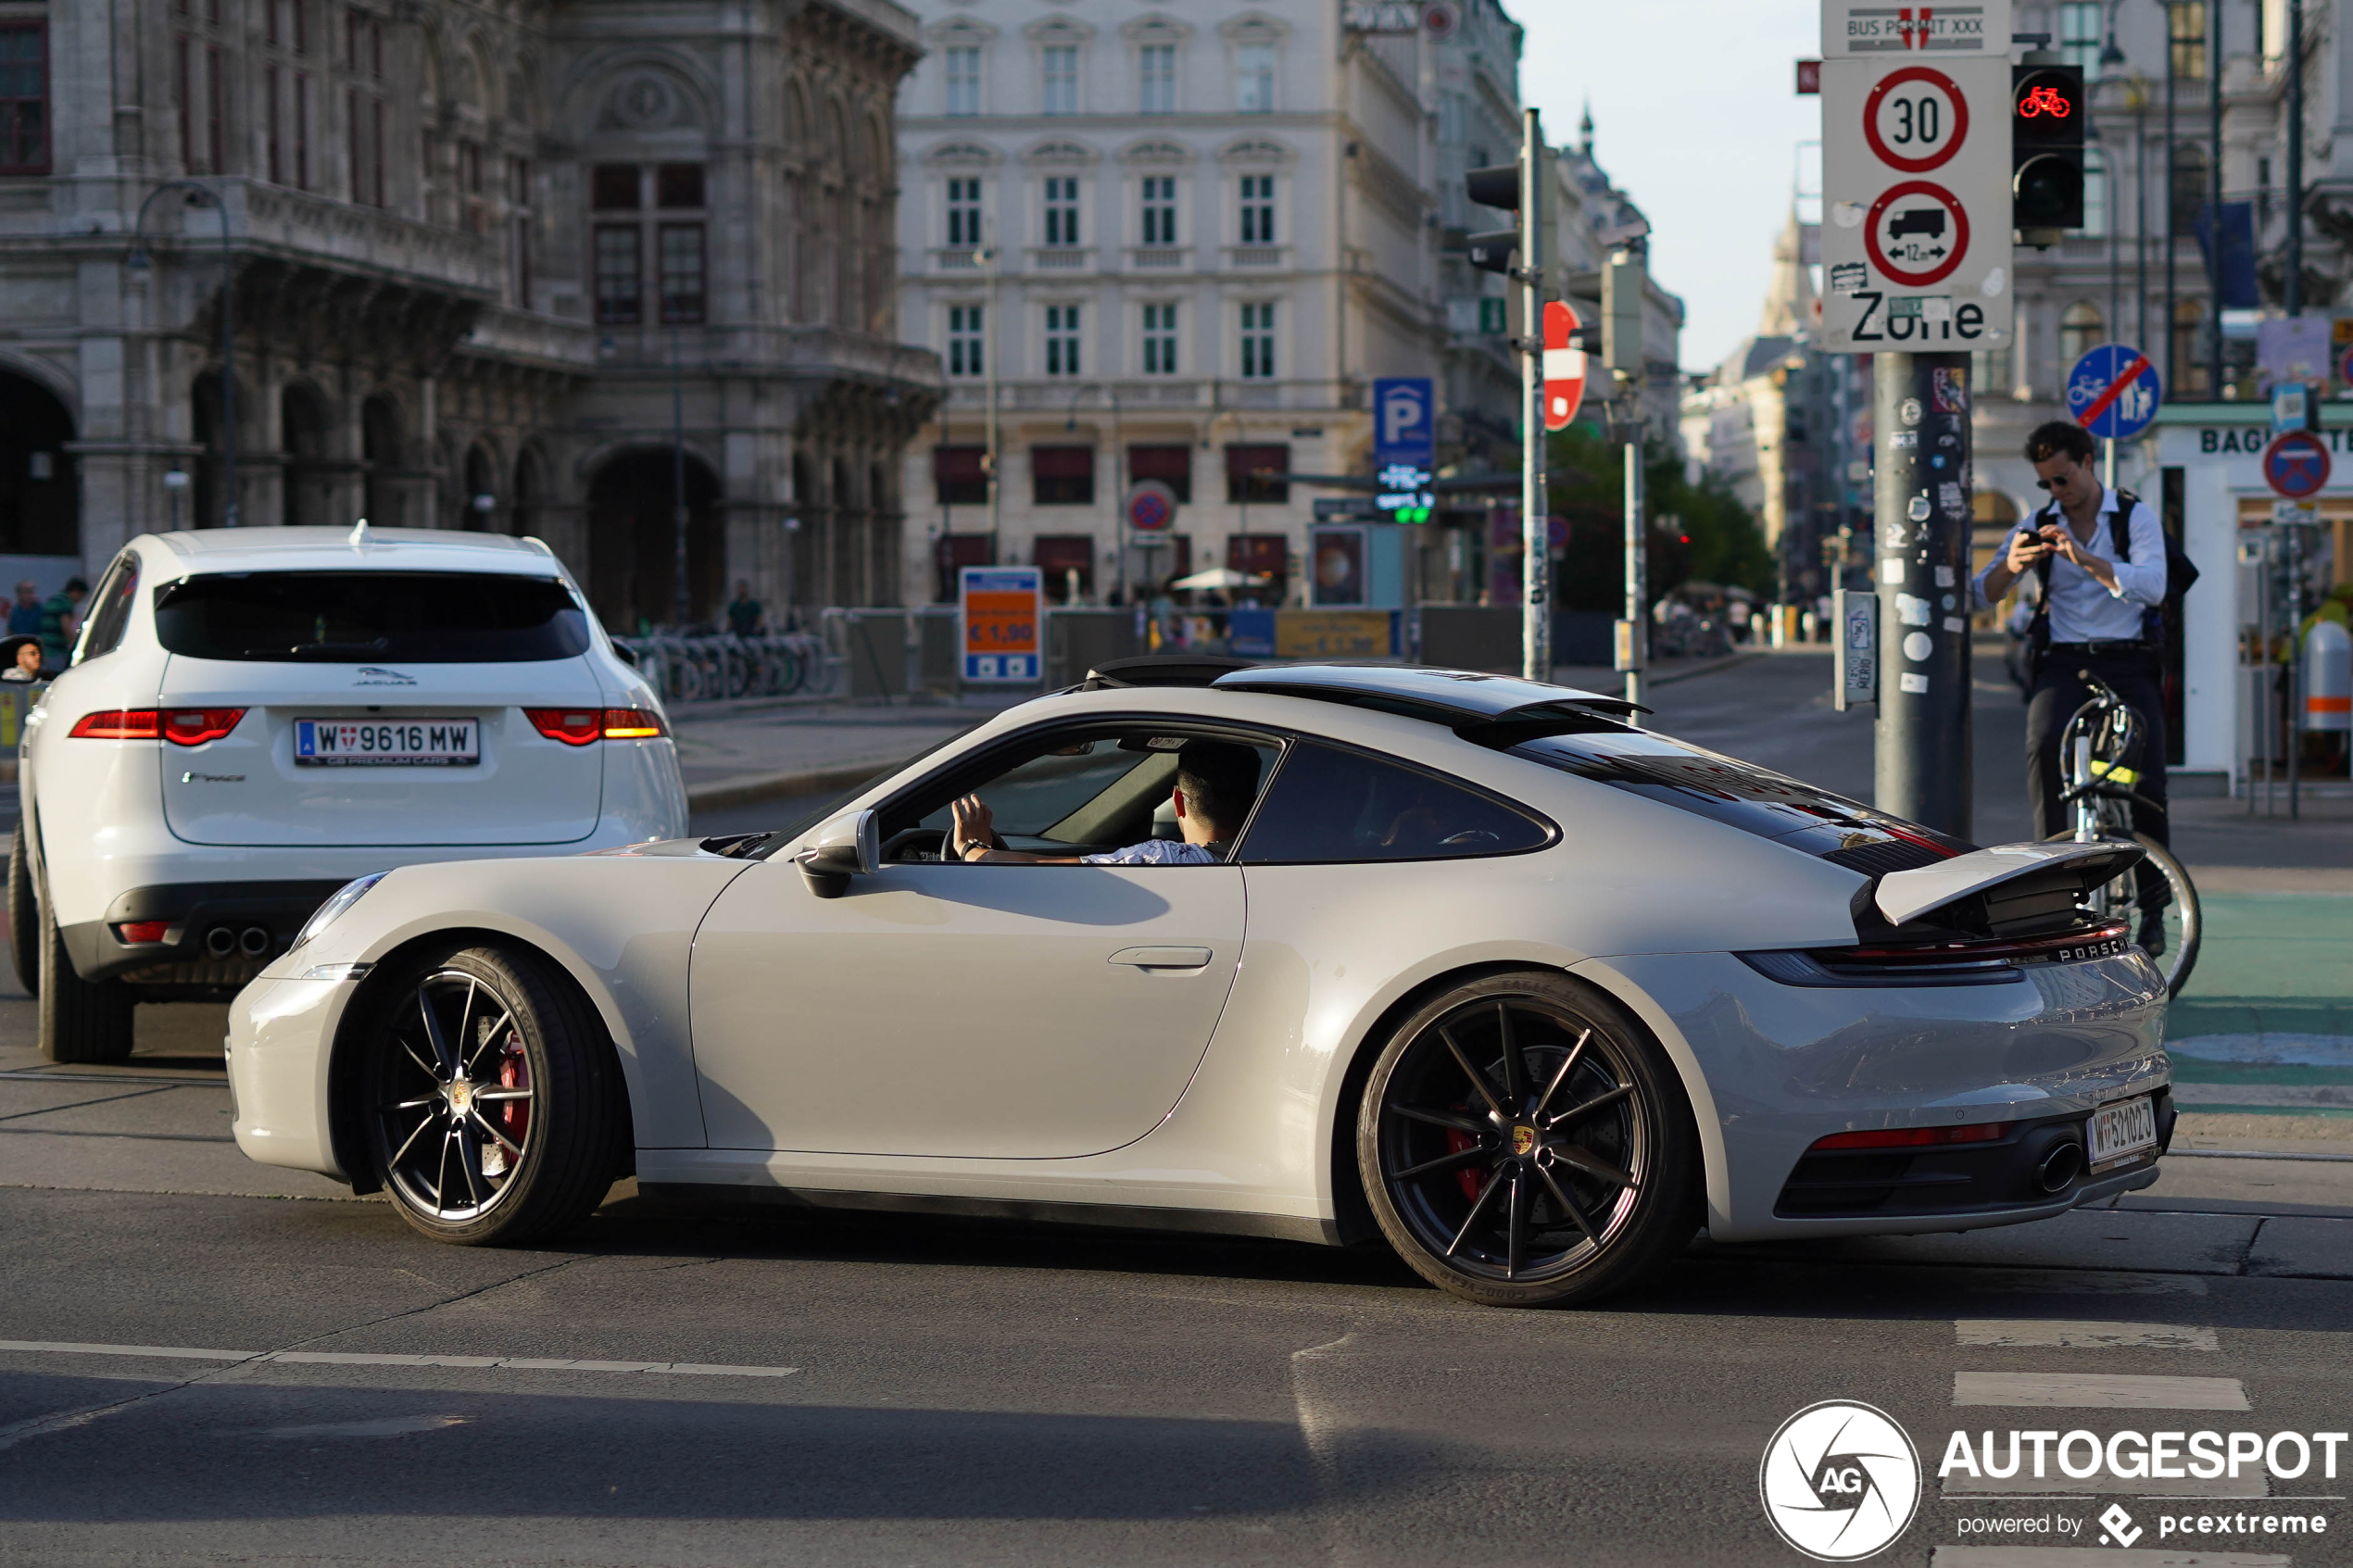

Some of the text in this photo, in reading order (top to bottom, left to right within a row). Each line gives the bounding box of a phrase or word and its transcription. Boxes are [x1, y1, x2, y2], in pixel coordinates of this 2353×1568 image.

[1848, 19, 1982, 35] BUS PERMIT XXX
[1893, 97, 1938, 144] 30
[1385, 399, 1422, 444] P
[970, 624, 982, 642] €
[319, 726, 468, 751] W 9616 MW
[2094, 1115, 2105, 1154] W
